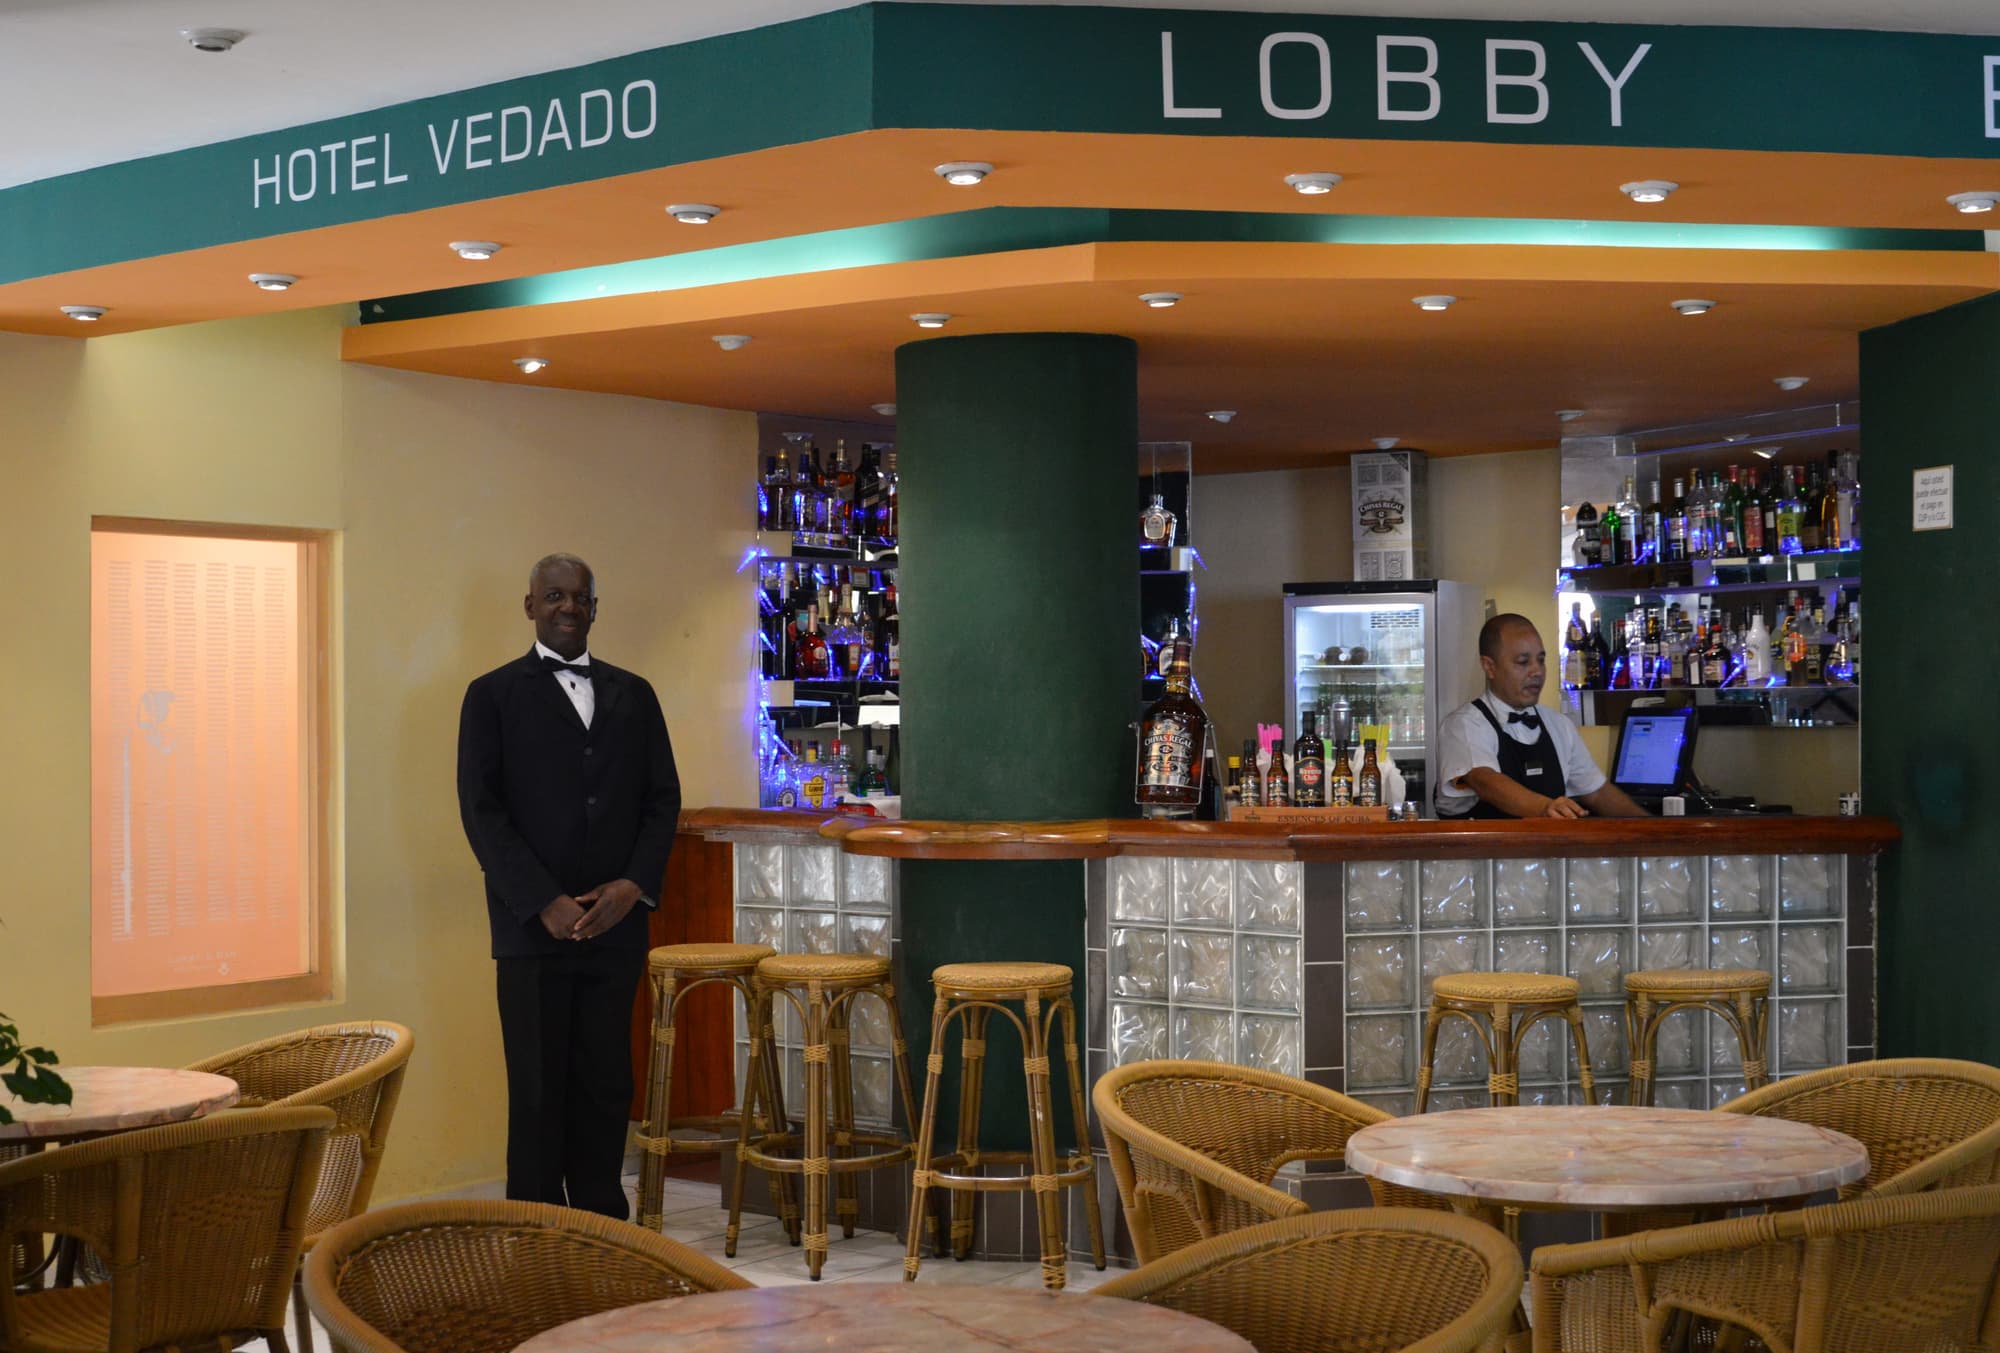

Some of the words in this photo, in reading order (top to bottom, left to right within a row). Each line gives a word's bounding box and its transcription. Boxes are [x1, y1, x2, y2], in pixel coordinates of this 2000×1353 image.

[1161, 30, 1651, 128] LOBBY
[253, 132, 408, 208] HOTEL
[428, 79, 658, 175] VEDADO
